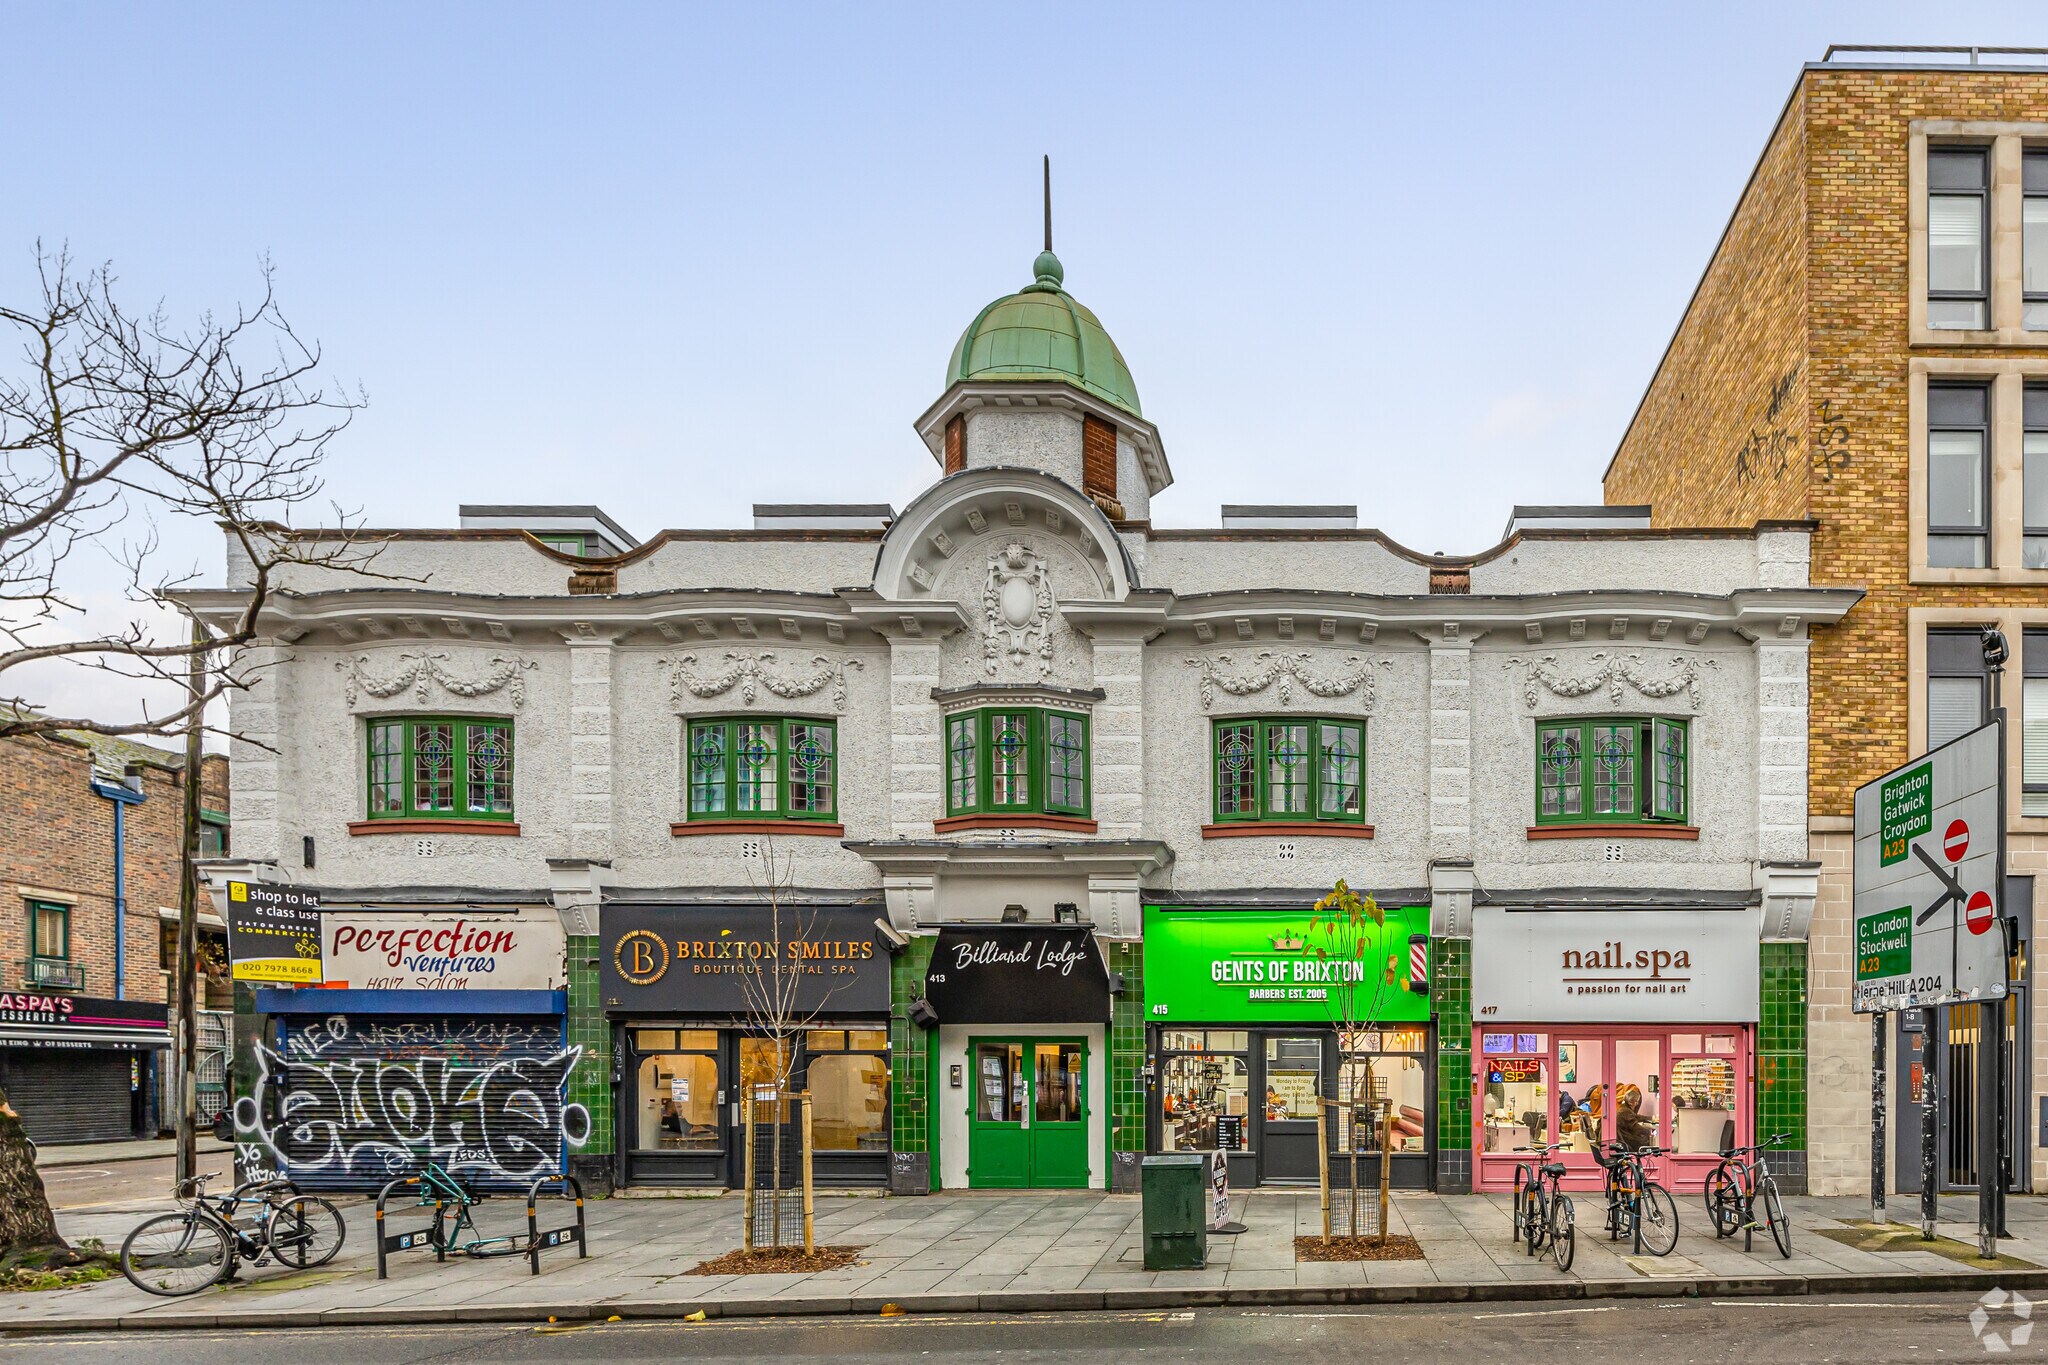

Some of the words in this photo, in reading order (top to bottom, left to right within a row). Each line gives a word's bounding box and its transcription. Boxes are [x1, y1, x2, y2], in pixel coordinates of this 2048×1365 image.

[1885, 773, 1929, 803] Brighton
[1884, 793, 1925, 821] Gatwick
[1884, 814, 1927, 840] Croydon
[1884, 839, 1905, 859] A23
[250, 889, 282, 904] shop
[286, 893, 299, 904] to
[303, 894, 319, 906] let
[255, 906, 263, 915] e
[266, 905, 295, 918] class
[299, 911, 319, 920] use
[237, 920, 274, 928] EATON
[280, 924, 315, 932] GREEN
[238, 927, 315, 939] COMMERCIAL
[1860, 923, 1870, 938] C.
[1873, 916, 1909, 934] London
[333, 920, 518, 967] Perfection
[677, 941, 781, 960] BRIXTON
[788, 941, 875, 960] SMILES
[1860, 933, 1908, 956] Stockwell
[952, 940, 1032, 970] Billiard
[1036, 939, 1088, 976] Lodge
[1561, 941, 1692, 977] nail.spa
[1859, 956, 1880, 974] A23
[242, 963, 261, 971] 020
[264, 964, 288, 973] 7978
[291, 966, 313, 974] 8668
[693, 964, 763, 975] BOUTIQUE
[772, 964, 824, 975] DENTAL
[831, 964, 856, 975] SPA
[1211, 960, 1265, 982] GENTS
[1268, 960, 1290, 982] OF
[1293, 960, 1364, 982] BRIXTON
[929, 974, 946, 983] 413
[1888, 979, 1906, 996] Hill
[1909, 975, 1942, 994] A204
[1249, 989, 1286, 999] BARBERS
[1288, 989, 1305, 999] EST.
[1306, 989, 1327, 999] 2005
[1567, 985, 1573, 993] a
[1578, 984, 1621, 995] passion
[1625, 984, 1641, 993] for
[1645, 984, 1666, 993] nail
[1670, 984, 1687, 993] art
[606, 997, 624, 1006] 41
[1152, 1004, 1168, 1015] 415
[1480, 1005, 1498, 1015] 417
[1905, 1013, 1915, 1021] 1-8
[1489, 1060, 1540, 1072] NAILS
[1492, 1072, 1502, 1082] &
[1504, 1071, 1536, 1082] SPA
